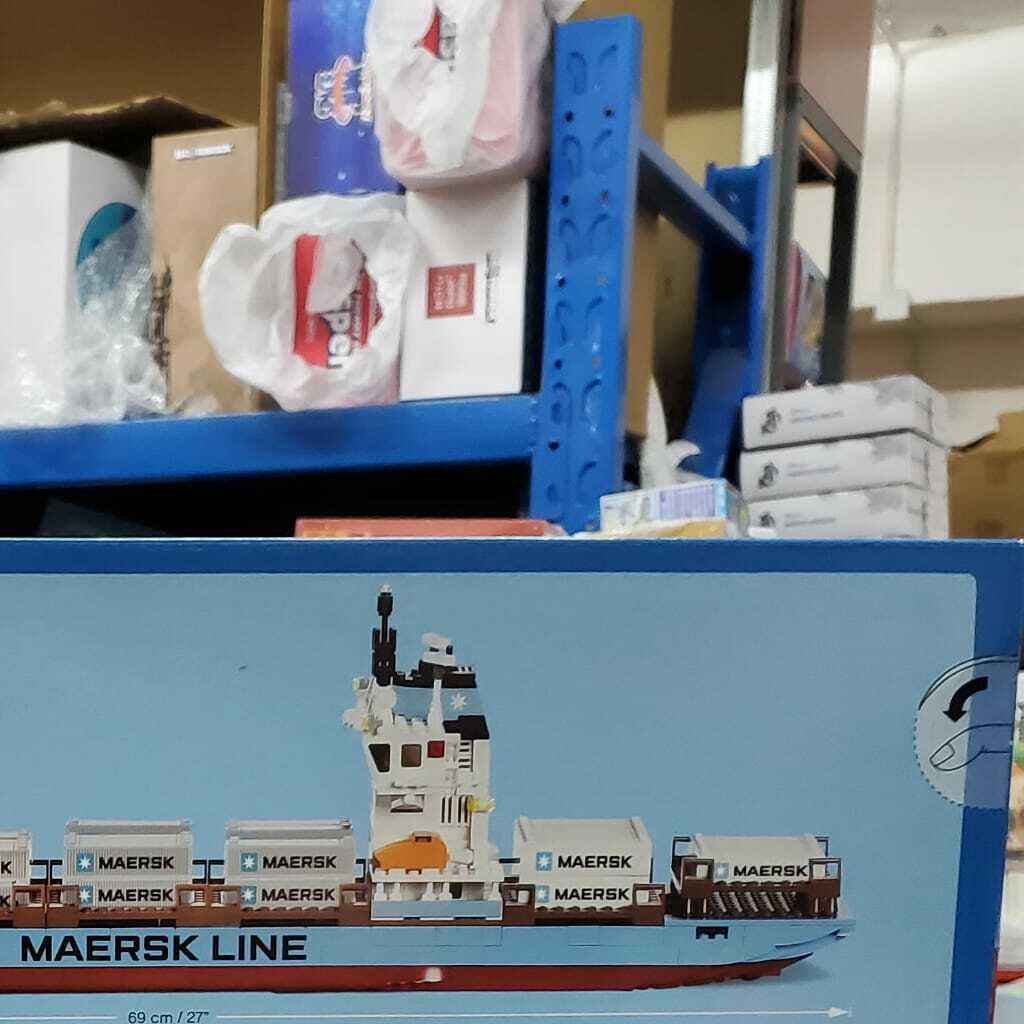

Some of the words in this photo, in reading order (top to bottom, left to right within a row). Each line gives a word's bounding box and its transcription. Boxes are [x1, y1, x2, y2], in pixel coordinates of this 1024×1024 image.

[98, 855, 174, 870] MAERSK
[262, 854, 337, 869] MAERSK
[557, 854, 633, 868] MAERSK
[733, 864, 808, 877] MAERSK
[97, 887, 173, 902] MAERSK
[261, 887, 335, 901] MAERSK
[554, 887, 630, 901] MAERSK
[21, 935, 199, 961] MAERSK
[212, 934, 307, 961] LINE
[127, 1011, 146, 1024] 69
[150, 1013, 173, 1024] cm
